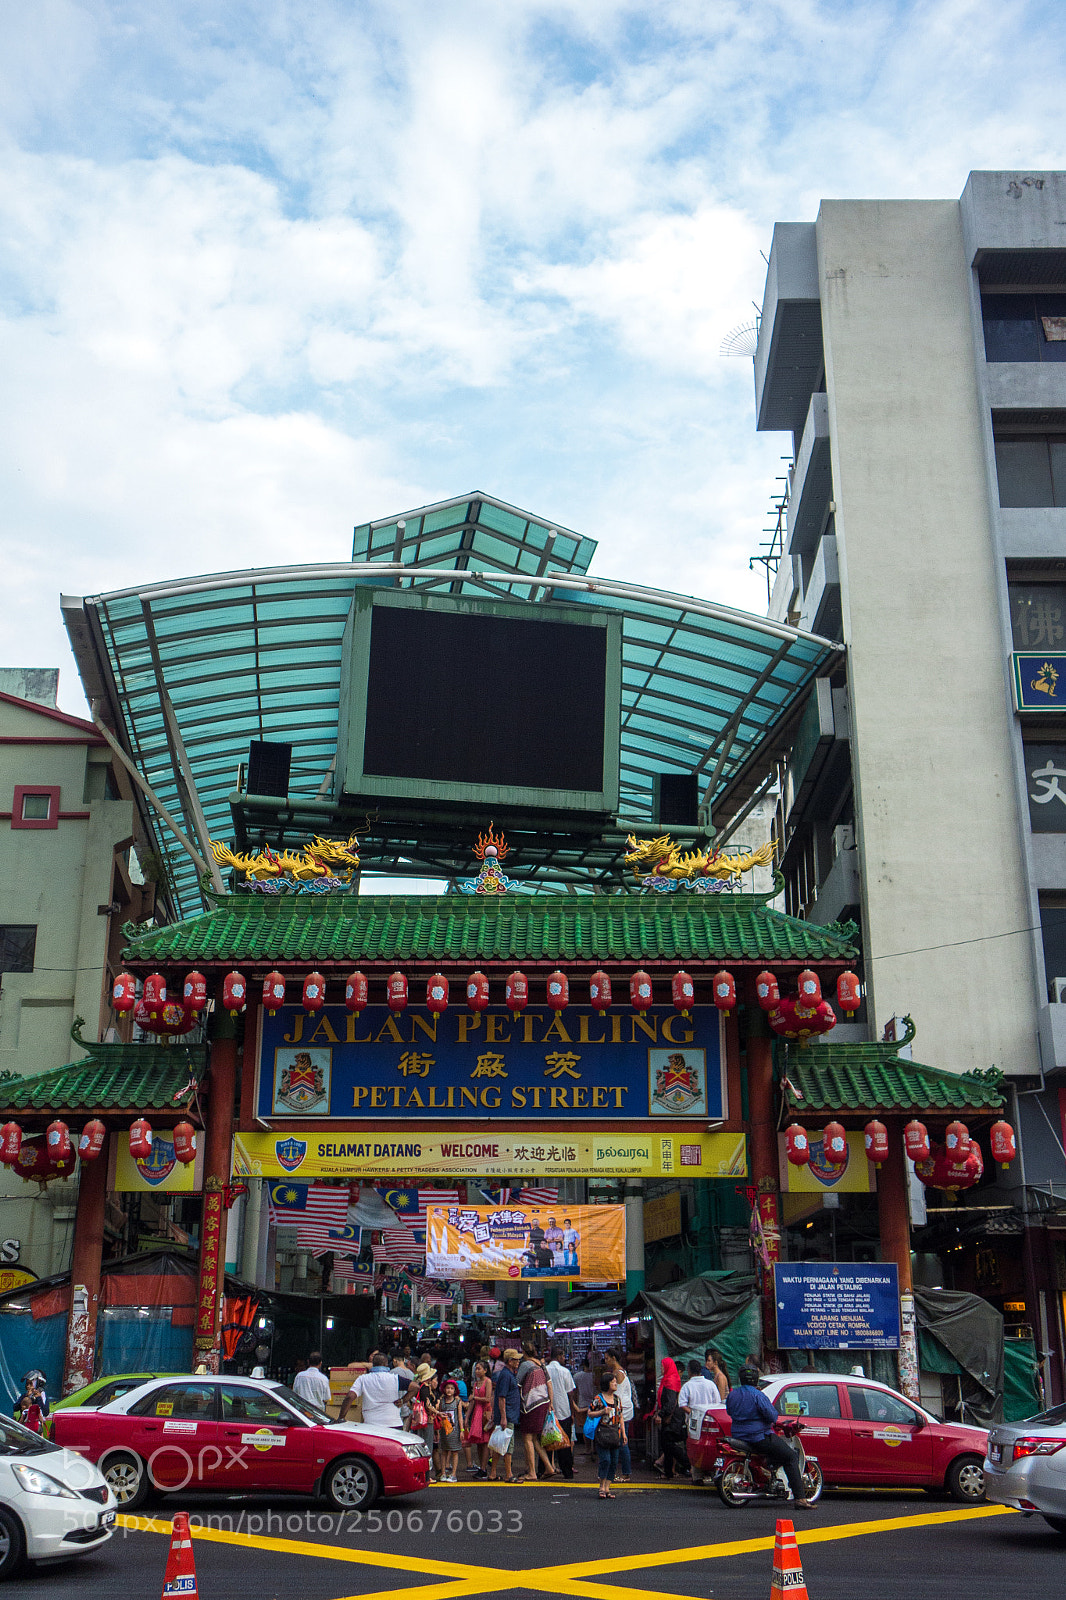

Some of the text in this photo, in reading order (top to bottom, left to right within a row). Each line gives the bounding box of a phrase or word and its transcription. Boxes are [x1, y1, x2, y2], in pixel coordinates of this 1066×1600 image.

[283, 1014, 697, 1044] JALAN PETALING
[351, 1086, 503, 1109] PETALING
[511, 1086, 628, 1109] STREET
[317, 1143, 371, 1157] SELAMAT
[373, 1143, 422, 1157] DATANG
[440, 1143, 499, 1158] WELCOME
[514, 1146, 576, 1161] 欢迎光临
[596, 1146, 649, 1160] நல்வரவு
[661, 1139, 673, 1172] 丙申年
[783, 1572, 804, 1586] POLIS
